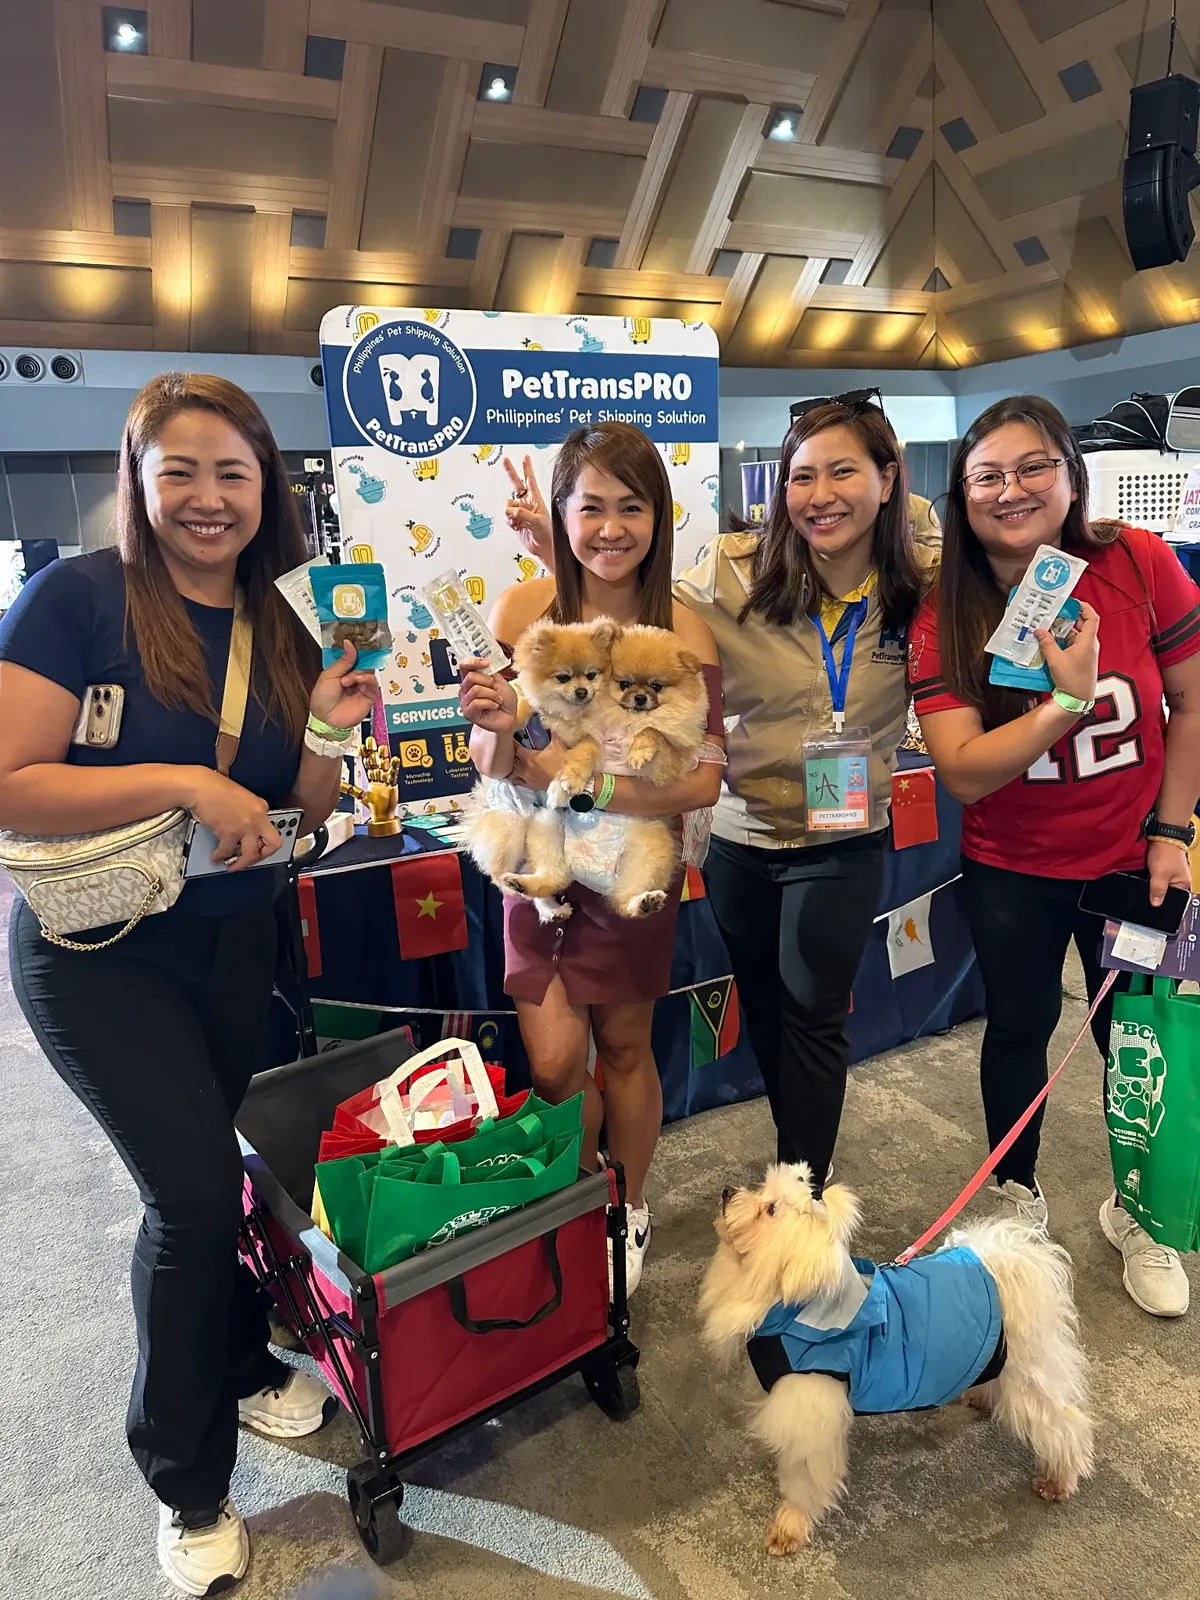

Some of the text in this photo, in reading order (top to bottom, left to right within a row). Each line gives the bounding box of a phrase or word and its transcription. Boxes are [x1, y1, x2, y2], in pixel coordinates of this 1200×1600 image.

[387, 327, 402, 338] Pet
[405, 326, 441, 346] Shipping
[441, 341, 466, 374] Solution
[502, 368, 692, 401] PetTransPRO
[569, 409, 592, 424] Pet
[598, 410, 652, 427] Shipping
[657, 410, 706, 424] Solution
[365, 416, 464, 454] PetTransPRO
[404, 777, 434, 785] Technology
[406, 772, 431, 780] Microchip
[445, 766, 473, 774] Laboratory
[815, 772, 840, 804] A
